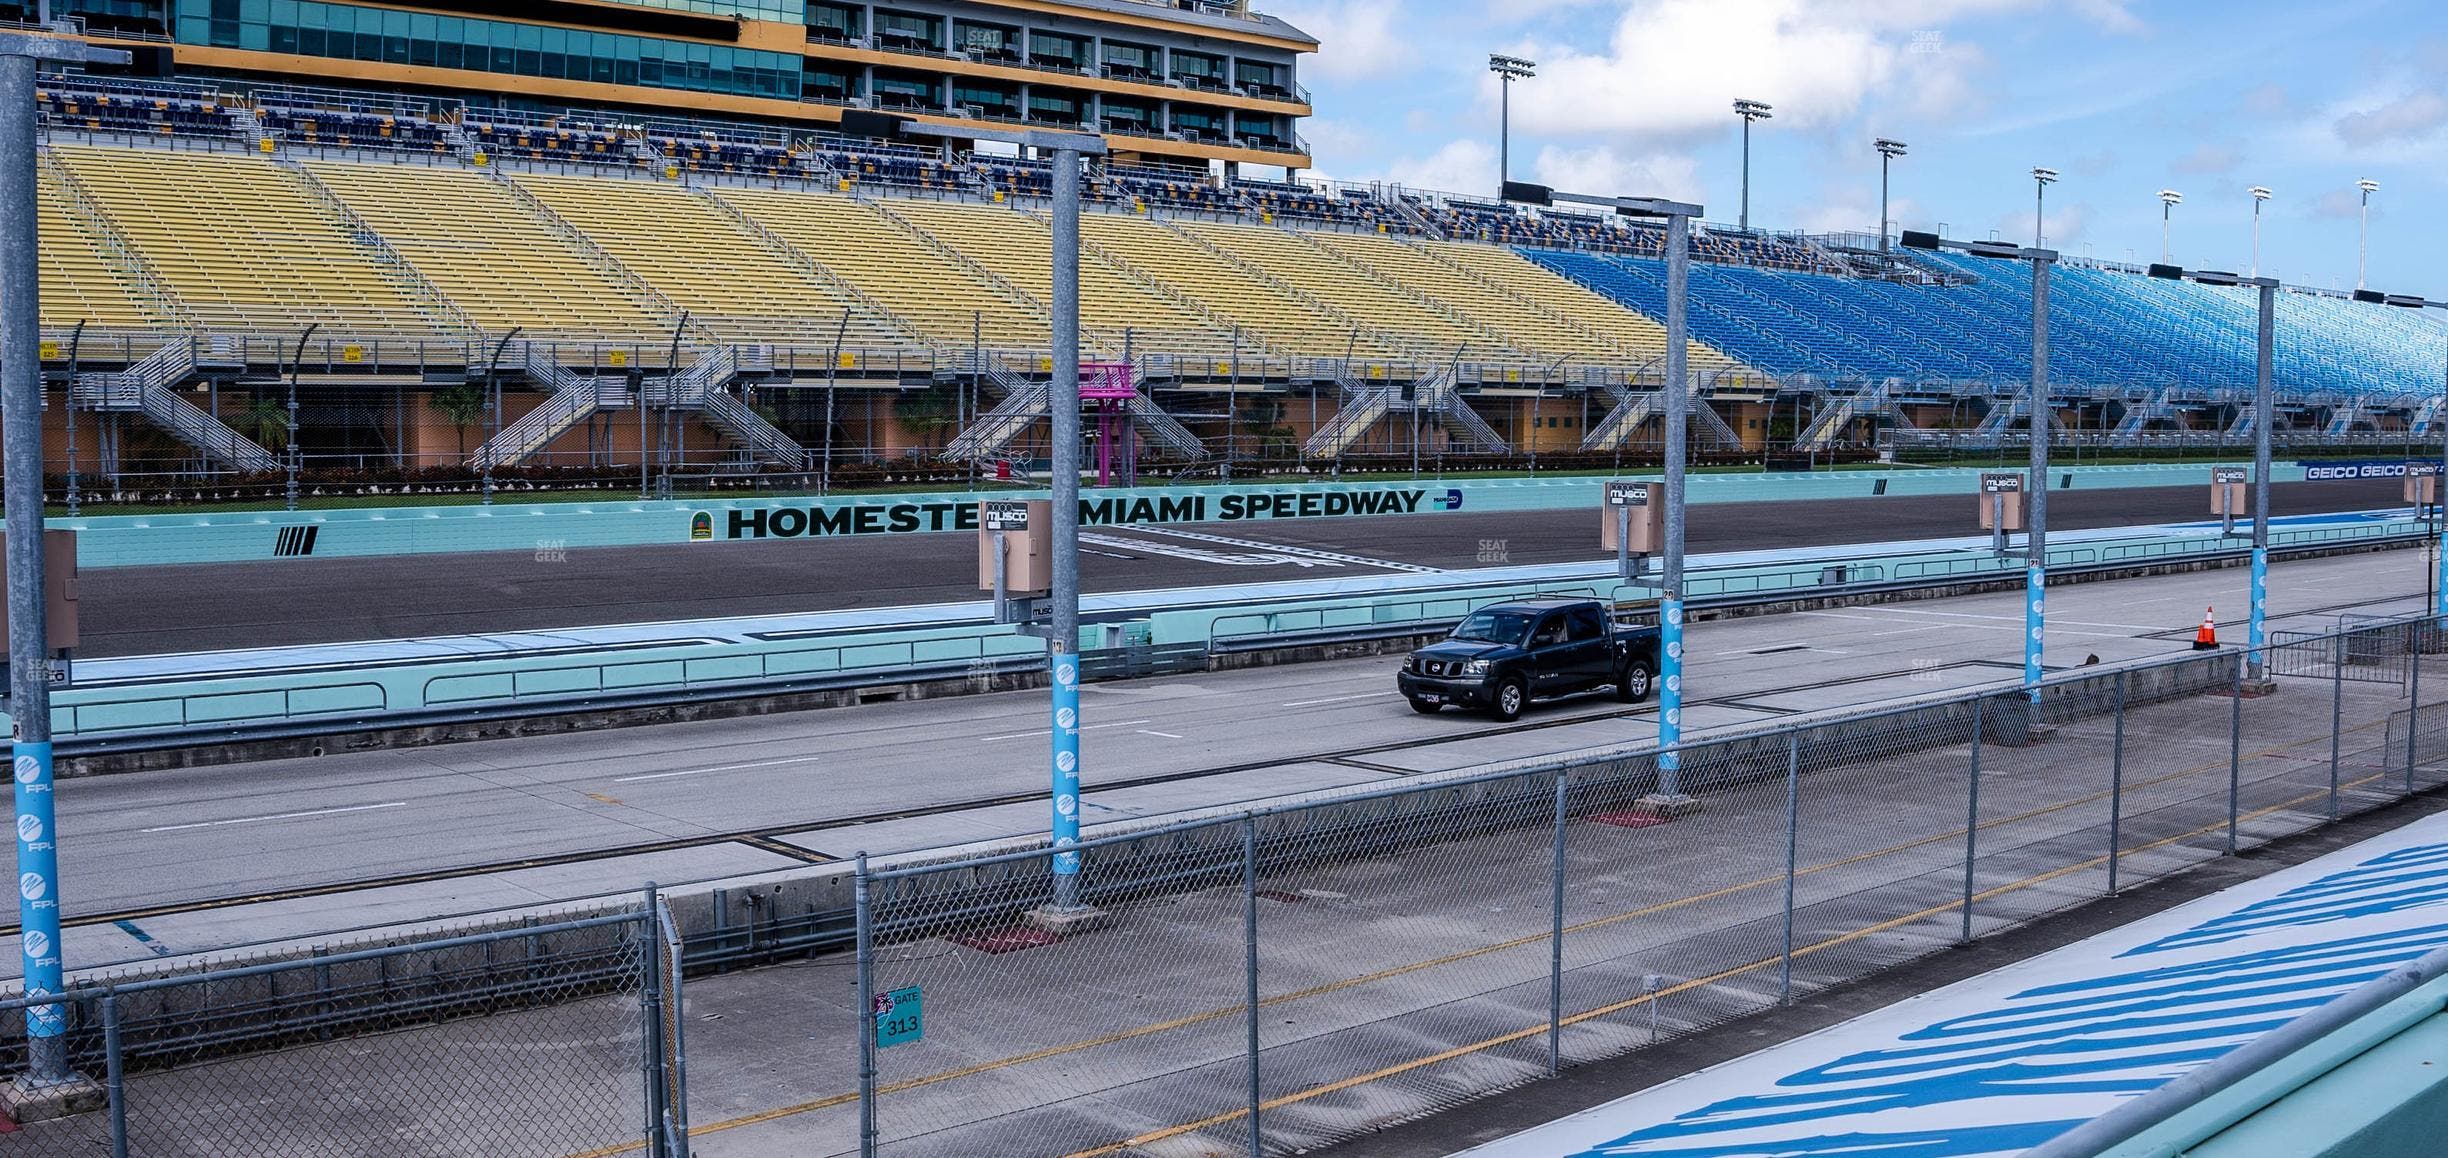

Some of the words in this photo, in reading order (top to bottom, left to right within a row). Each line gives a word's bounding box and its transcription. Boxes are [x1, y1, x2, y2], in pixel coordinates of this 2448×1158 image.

[2308, 466, 2358, 479] GEICO
[2361, 465, 2405, 477] GEICO
[727, 503, 980, 538] HOMESTE
[1078, 496, 1205, 525] MIAMI
[1218, 490, 1426, 521] SPEEDWAY
[26, 784, 52, 793] FPL
[28, 842, 54, 852] FPL
[31, 900, 58, 910] FPL
[35, 957, 62, 967] FPL
[894, 991, 918, 1005] GATE
[887, 1016, 918, 1037] 313
